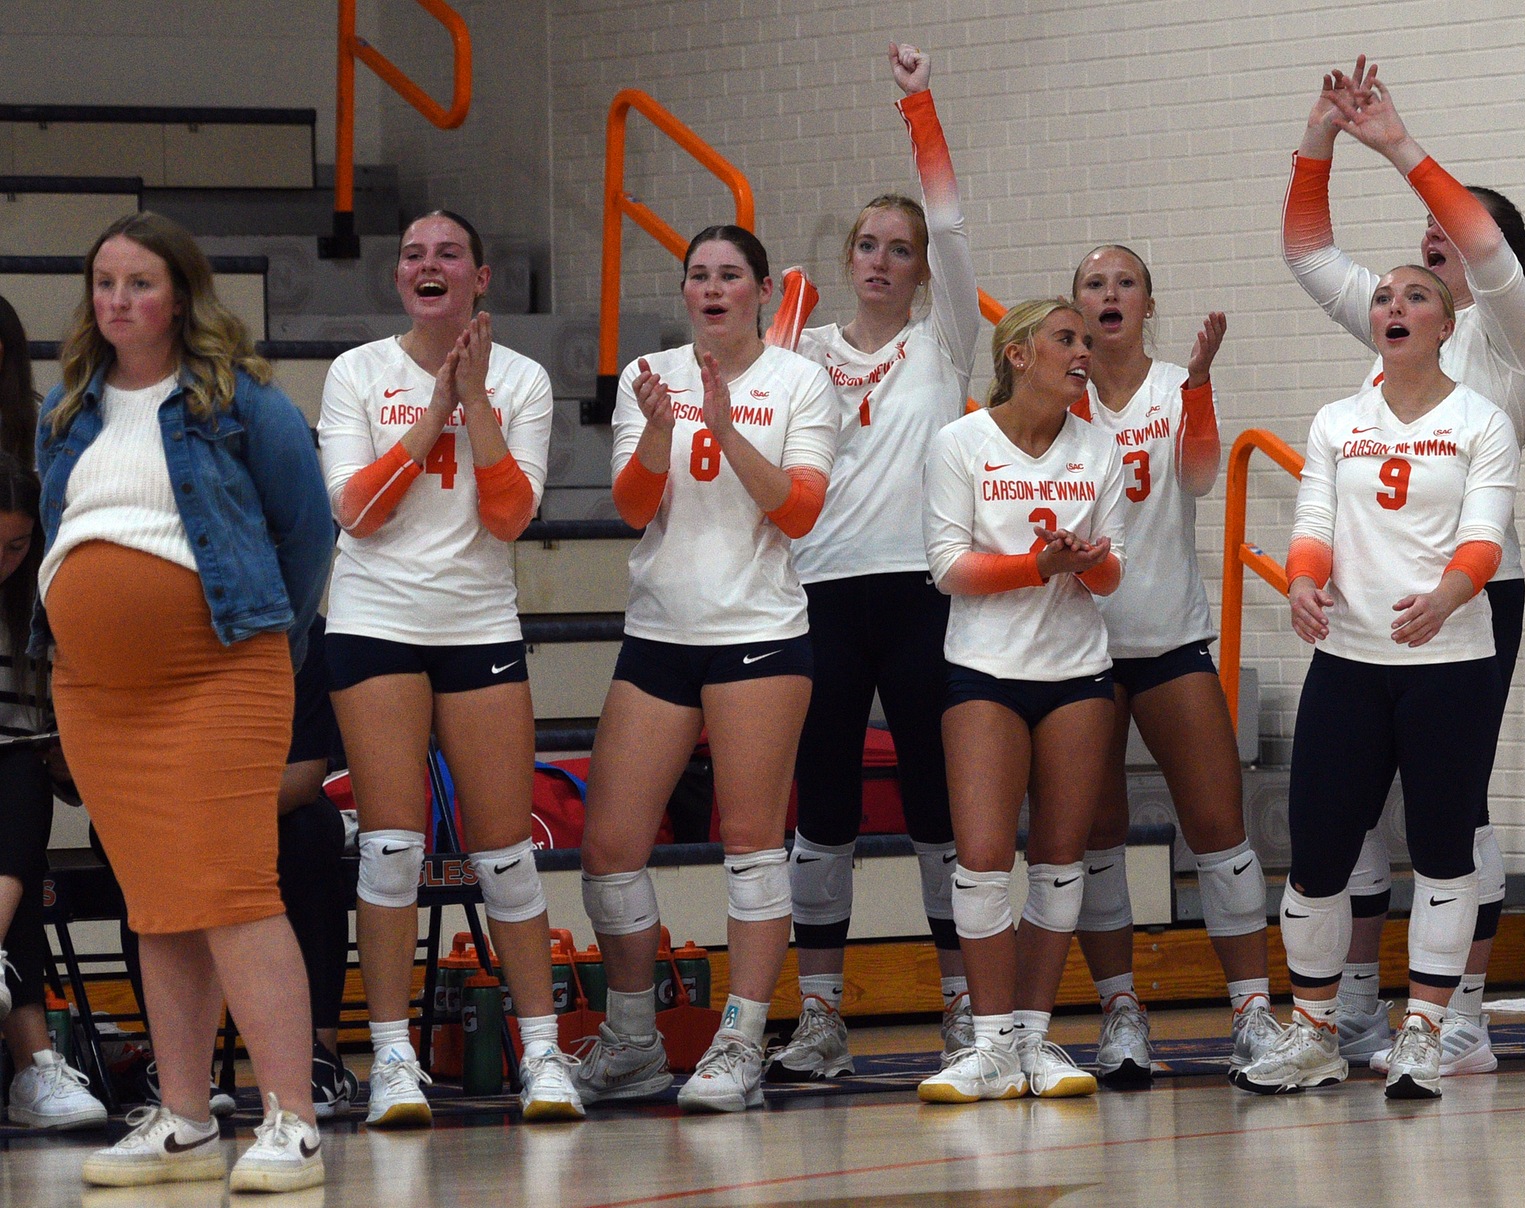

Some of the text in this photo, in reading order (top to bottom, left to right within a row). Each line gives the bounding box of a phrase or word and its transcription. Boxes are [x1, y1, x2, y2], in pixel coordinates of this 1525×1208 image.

[751, 388, 770, 399] SAC
[1434, 428, 1453, 437] SAC
[425, 432, 458, 489] 4
[689, 428, 722, 483] 8
[1342, 439, 1457, 458] CARSON-NEWMAN
[1066, 463, 1085, 473] SAC
[1122, 449, 1151, 504] 3
[982, 480, 1096, 502] CARSON-NEWMAN
[1376, 457, 1412, 511] 9
[417, 859, 480, 888] LES
[552, 981, 568, 1008] G
[462, 1005, 478, 1032] G
